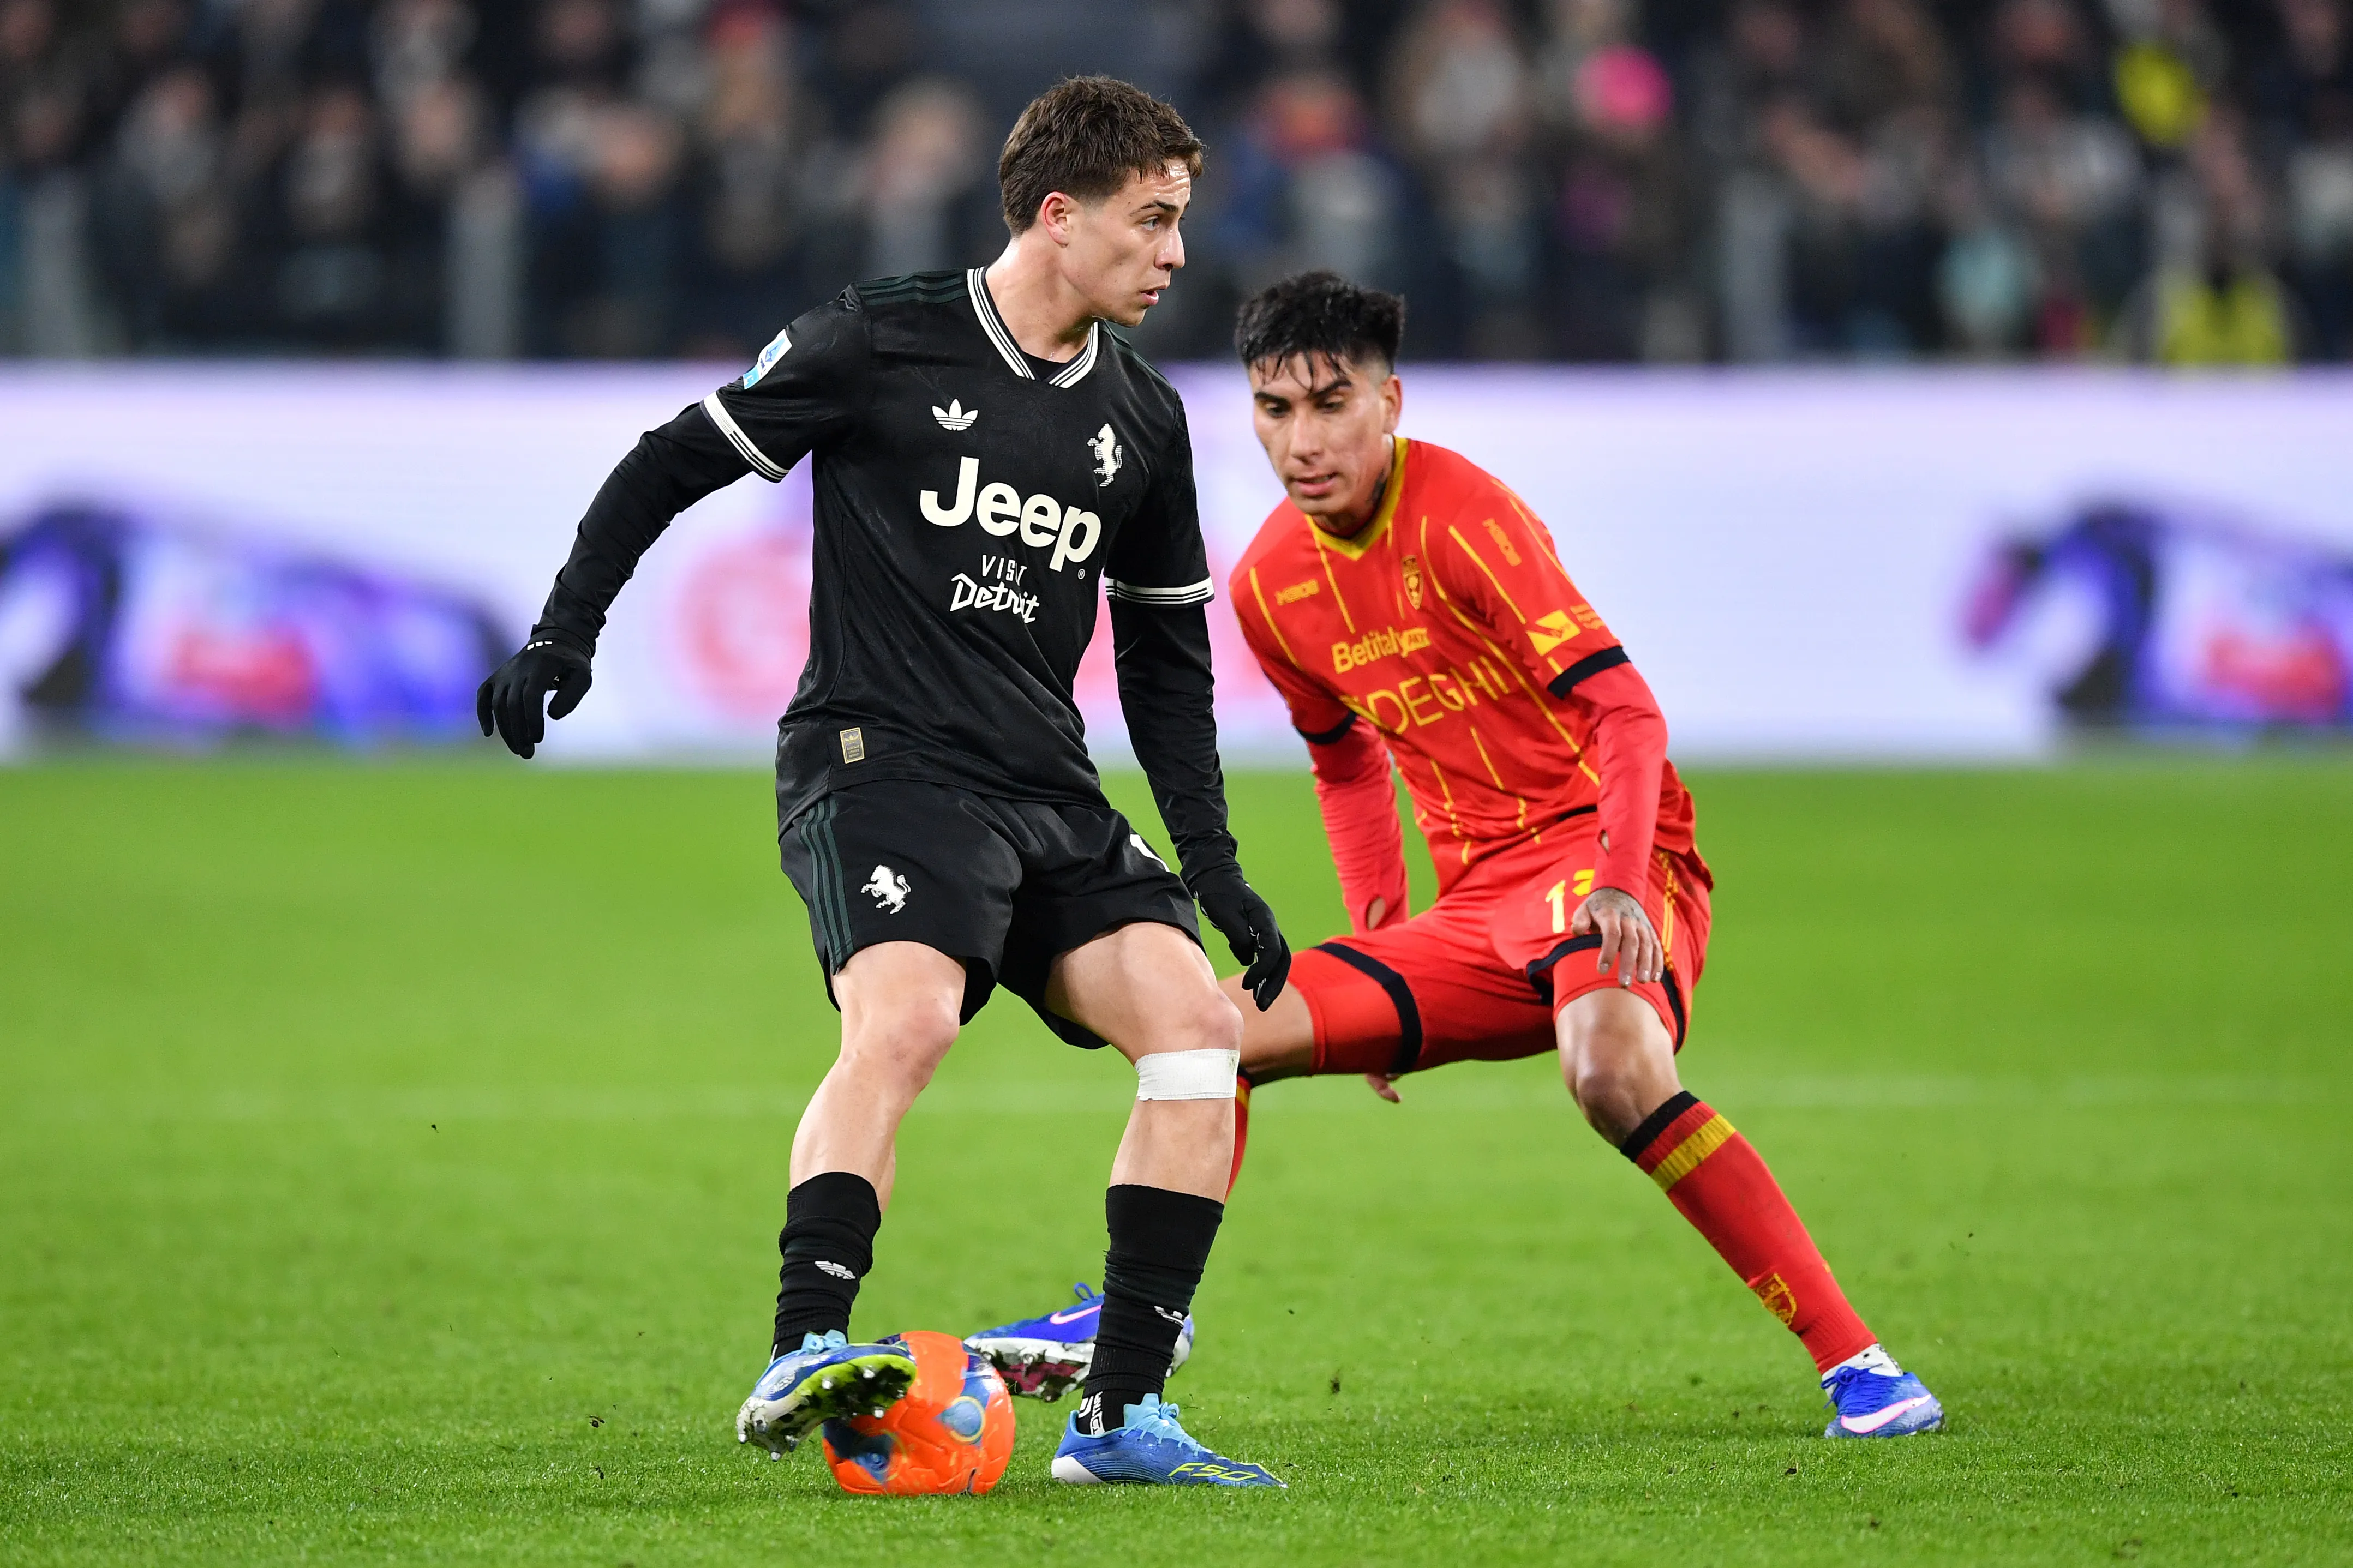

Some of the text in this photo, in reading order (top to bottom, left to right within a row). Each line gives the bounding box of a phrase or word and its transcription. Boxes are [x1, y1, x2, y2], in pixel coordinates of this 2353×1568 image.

[920, 456, 1101, 572] Jeep
[1366, 656, 1510, 735] DEGHI
[1167, 1462, 1258, 1481] F50
